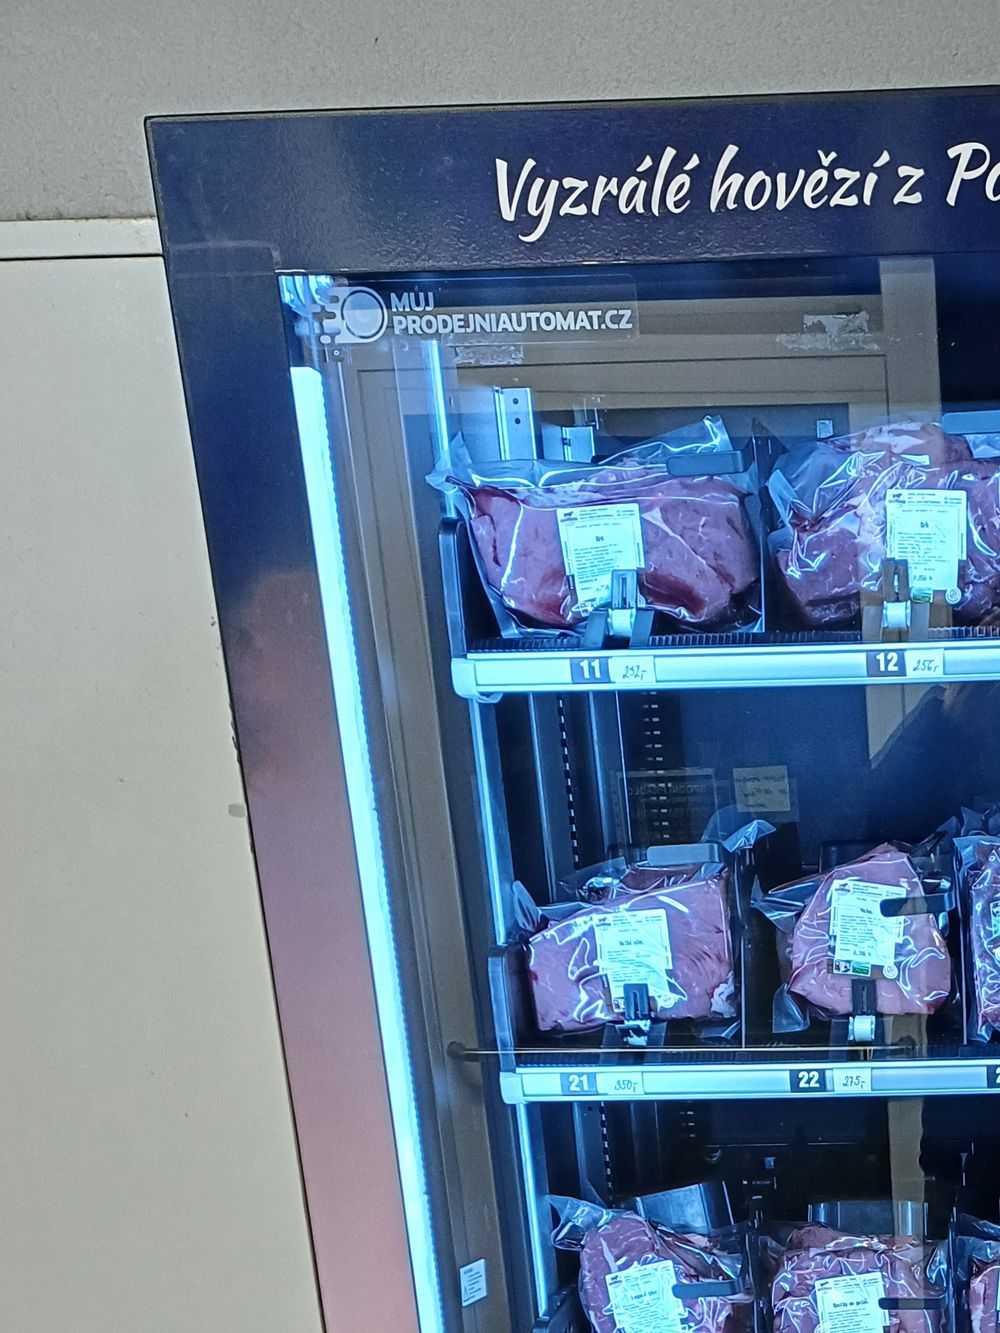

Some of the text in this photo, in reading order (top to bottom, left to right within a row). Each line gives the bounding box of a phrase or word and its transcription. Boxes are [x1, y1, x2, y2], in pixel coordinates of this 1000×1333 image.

[495, 145, 699, 244] Vyzrálé
[709, 144, 890, 216] hovězí
[894, 165, 925, 205] z
[393, 309, 633, 335] PRODEJNIAUTOMAT.CZ
[580, 659, 601, 679] 11
[876, 652, 899, 672] 12
[568, 1074, 590, 1091] 21
[798, 1071, 819, 1088] 22
